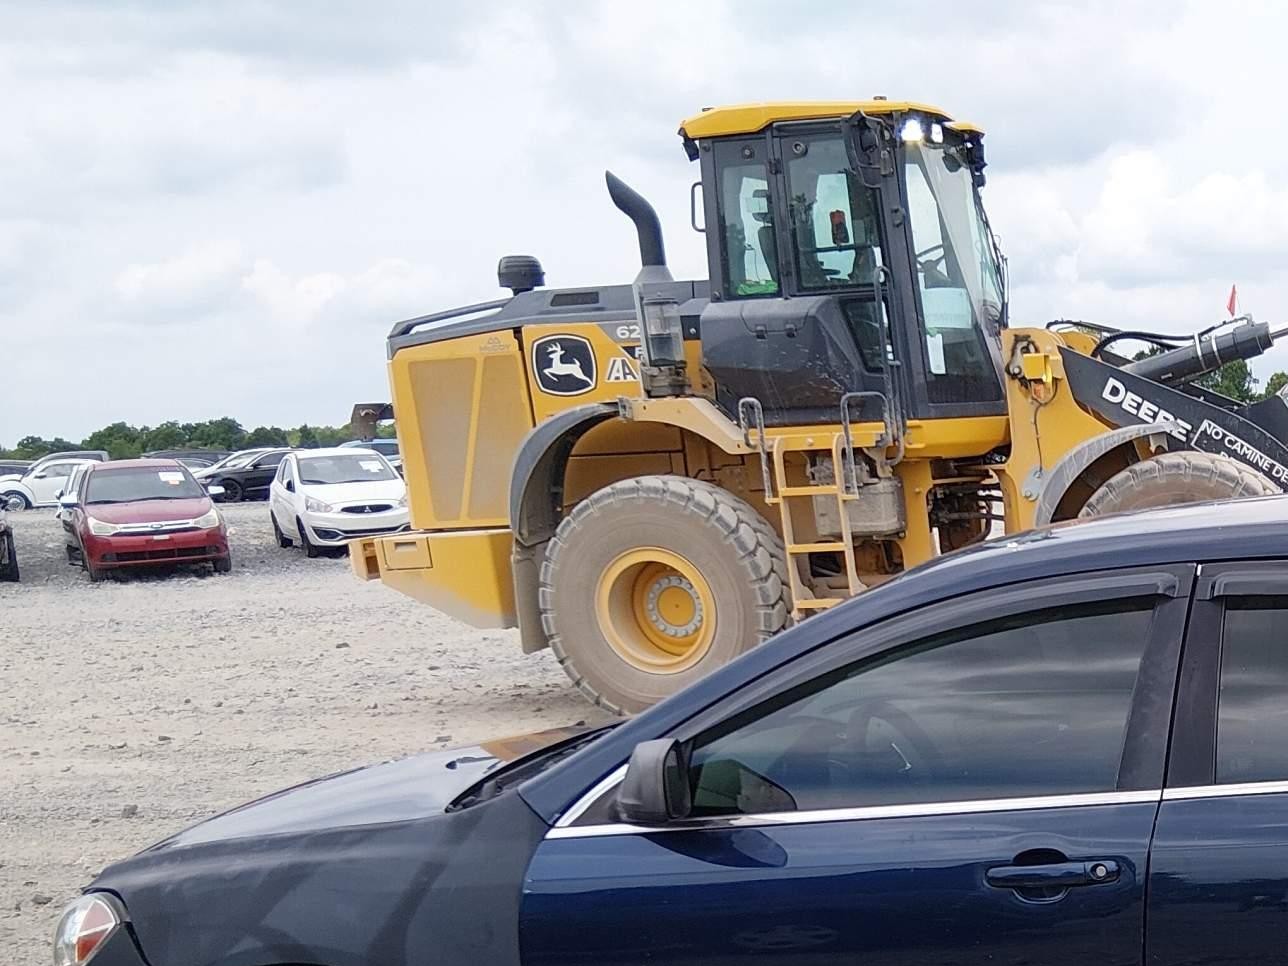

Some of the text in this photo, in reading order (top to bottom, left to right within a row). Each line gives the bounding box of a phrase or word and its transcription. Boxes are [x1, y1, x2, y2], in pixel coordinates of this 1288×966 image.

[1102, 377, 1193, 442] DEERE
[1203, 421, 1223, 440] NO
[1224, 437, 1273, 471] CAMINE
